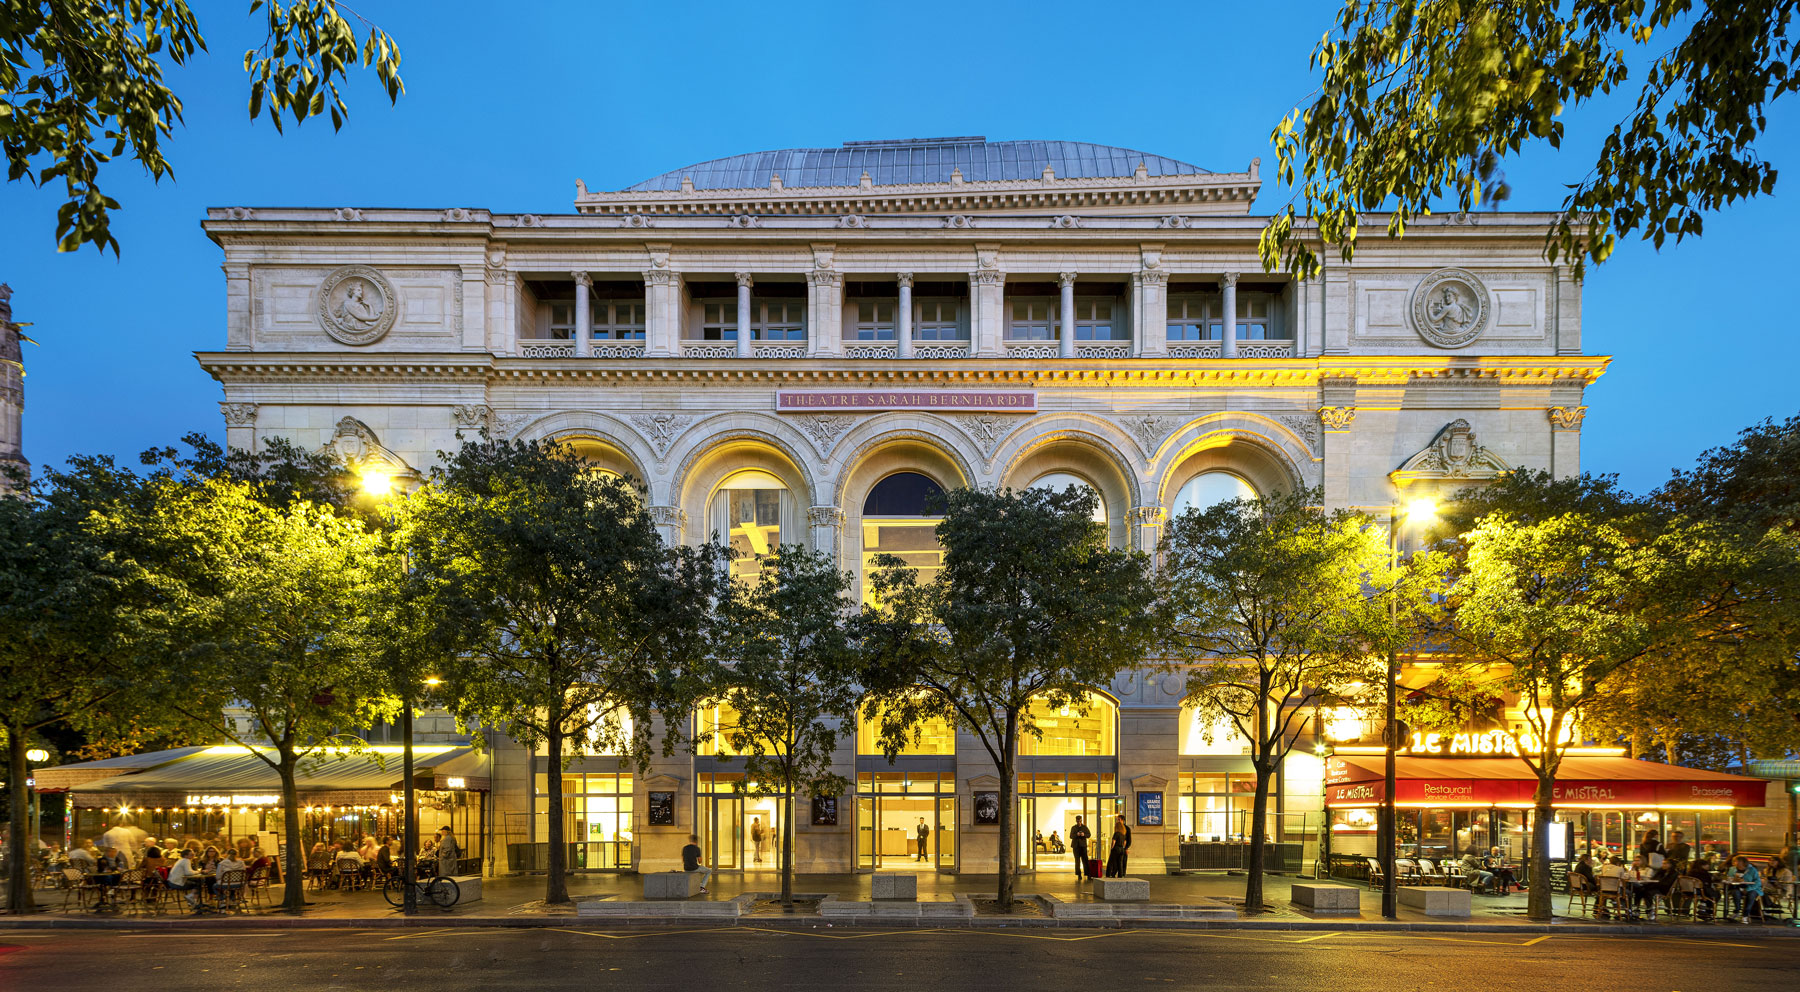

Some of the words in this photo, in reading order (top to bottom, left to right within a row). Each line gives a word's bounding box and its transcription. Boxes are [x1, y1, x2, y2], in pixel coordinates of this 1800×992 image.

[867, 394, 920, 405] SARAH
[930, 394, 1027, 405] BERNHARDT
[1411, 732, 1441, 753] LE
[1336, 789, 1345, 800] LE
[1345, 785, 1374, 800] MISTRAL
[1424, 783, 1472, 794] Restaurant
[1565, 786, 1615, 800] MISTRAL
[1691, 785, 1733, 796] Brasserie
